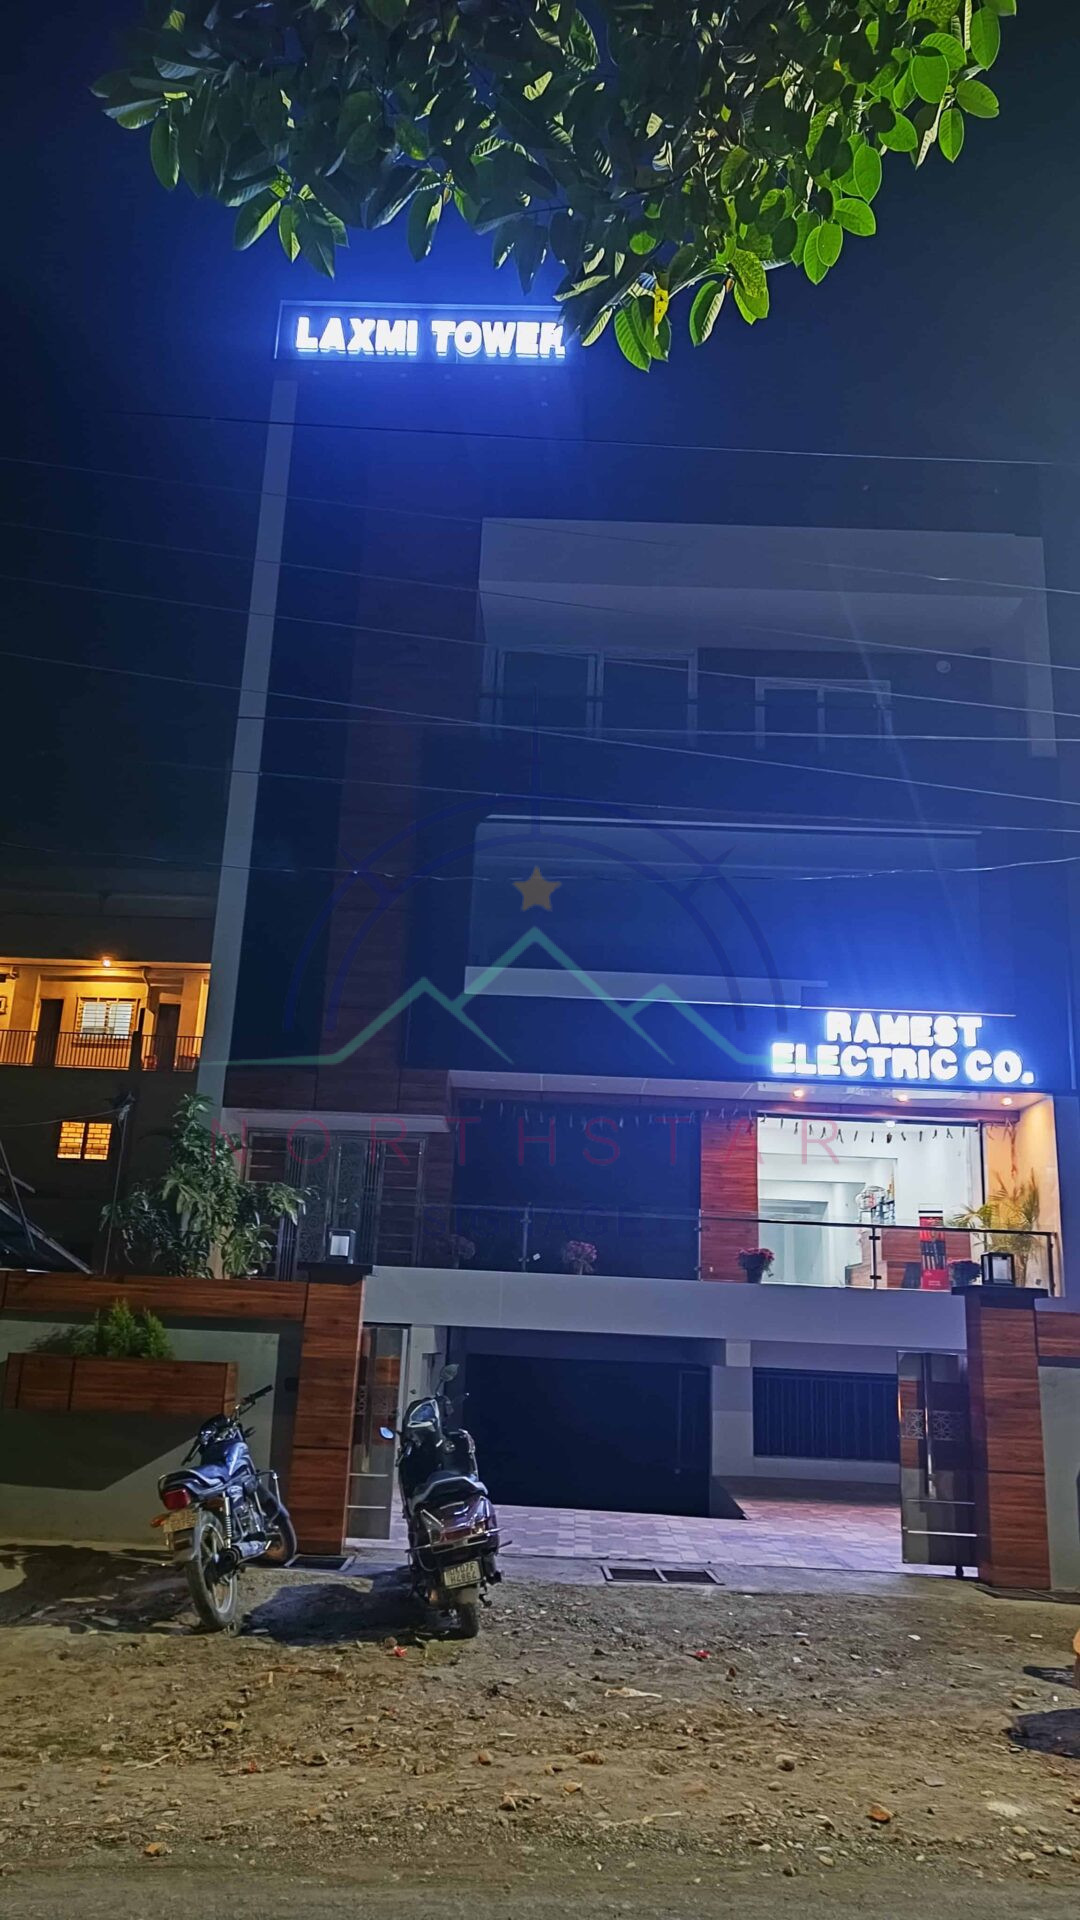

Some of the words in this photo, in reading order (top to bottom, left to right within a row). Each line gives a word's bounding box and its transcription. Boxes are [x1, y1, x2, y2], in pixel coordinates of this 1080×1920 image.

[295, 315, 419, 356] LAXMI
[825, 1010, 984, 1048] RAMEST
[770, 1041, 959, 1082] ELECTRIC
[964, 1049, 1036, 1086] CO.
